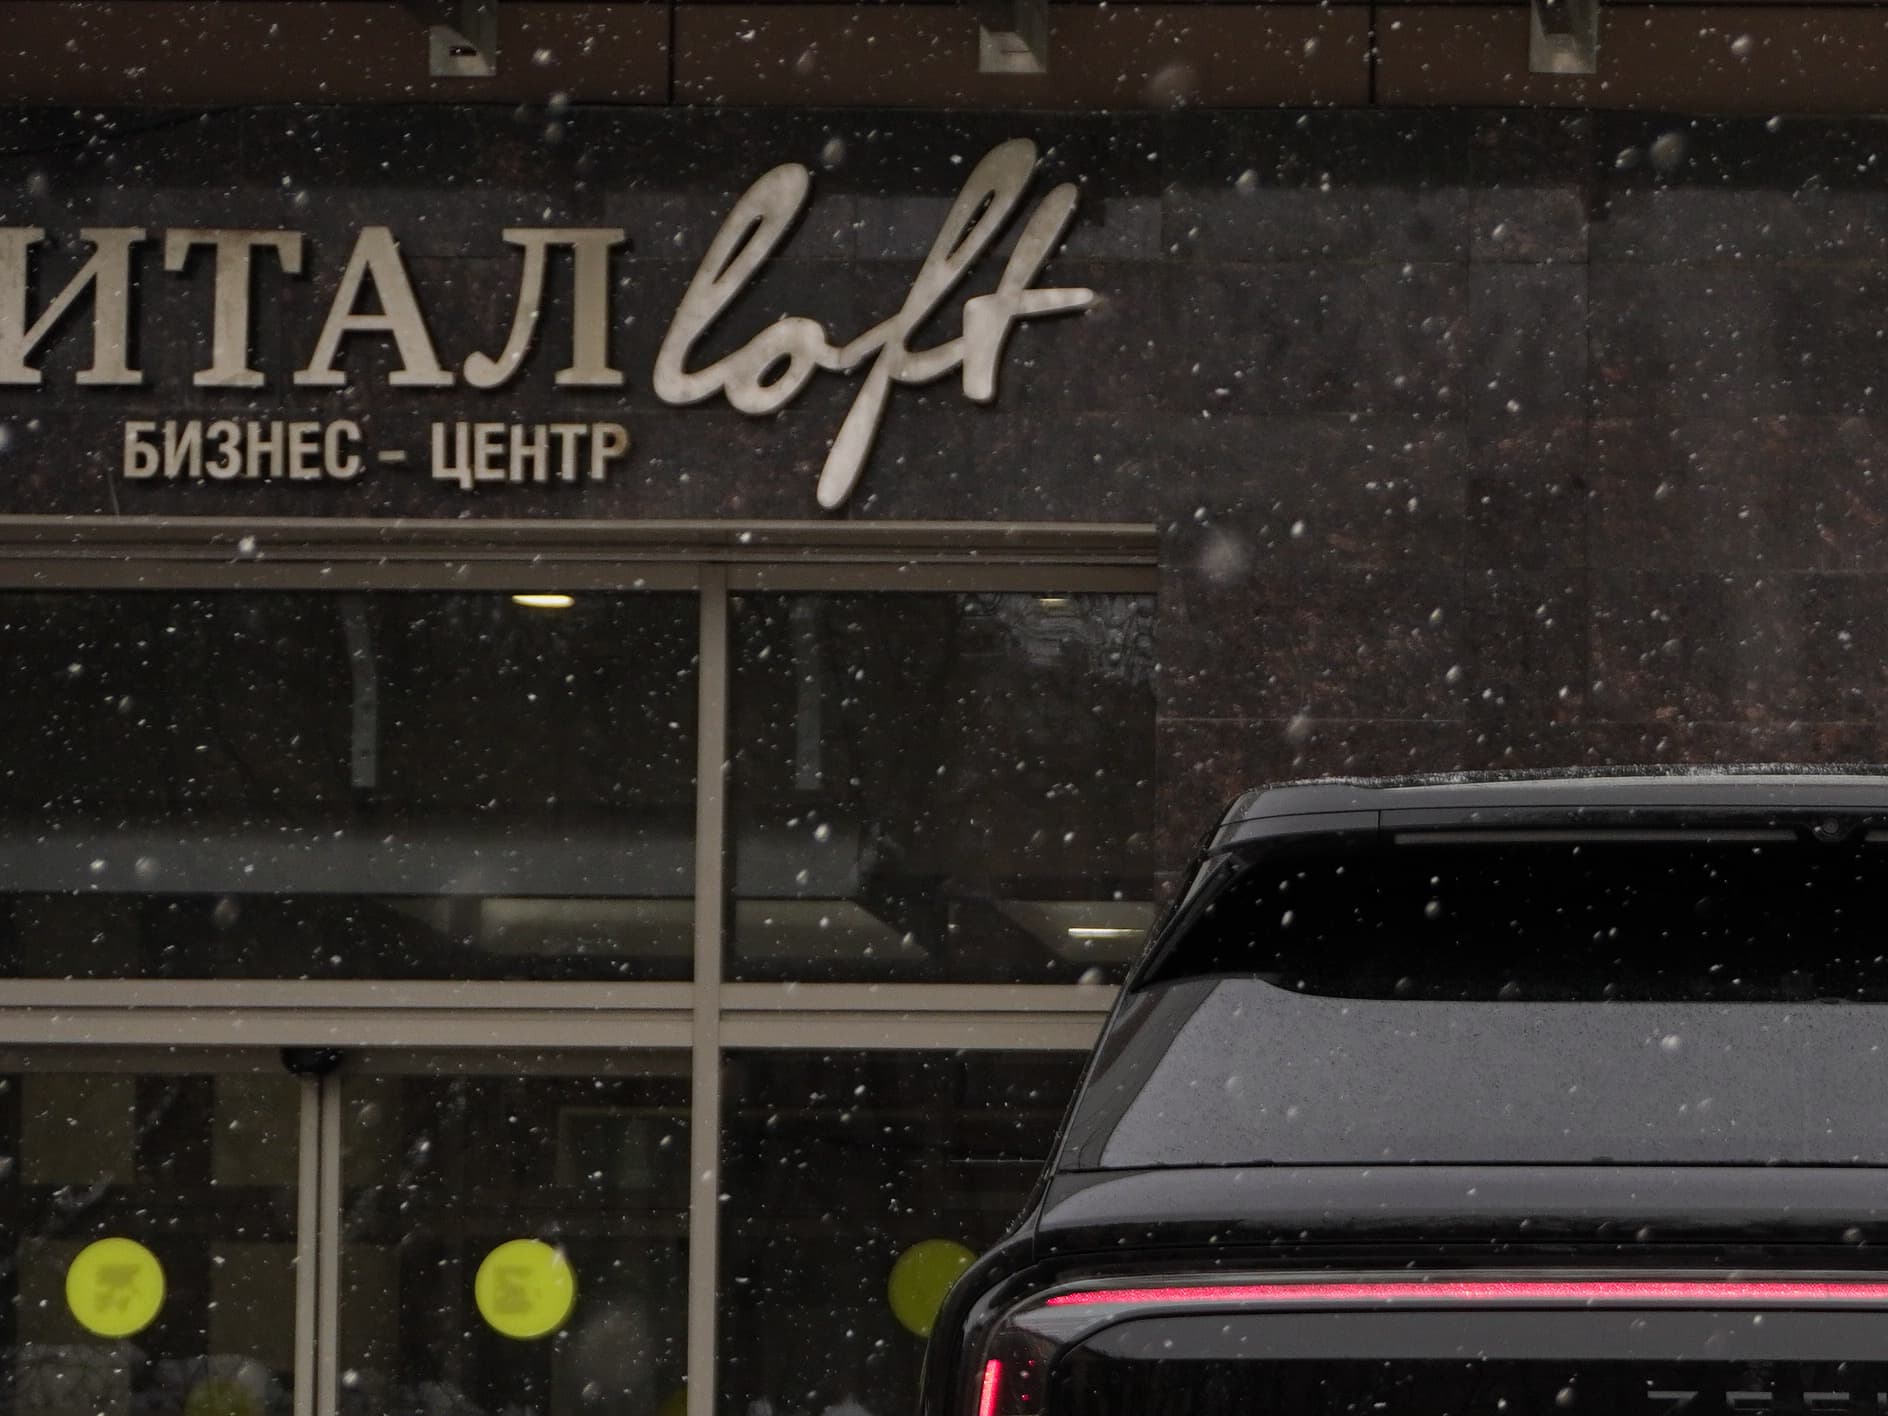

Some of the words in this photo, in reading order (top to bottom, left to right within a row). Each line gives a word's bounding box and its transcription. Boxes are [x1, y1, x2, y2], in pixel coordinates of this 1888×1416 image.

[0, 226, 627, 387] ИТАЛ
[652, 136, 1096, 510] loft
[123, 419, 362, 480] БИЗНЕС
[431, 421, 630, 490] ЦЕНТР
